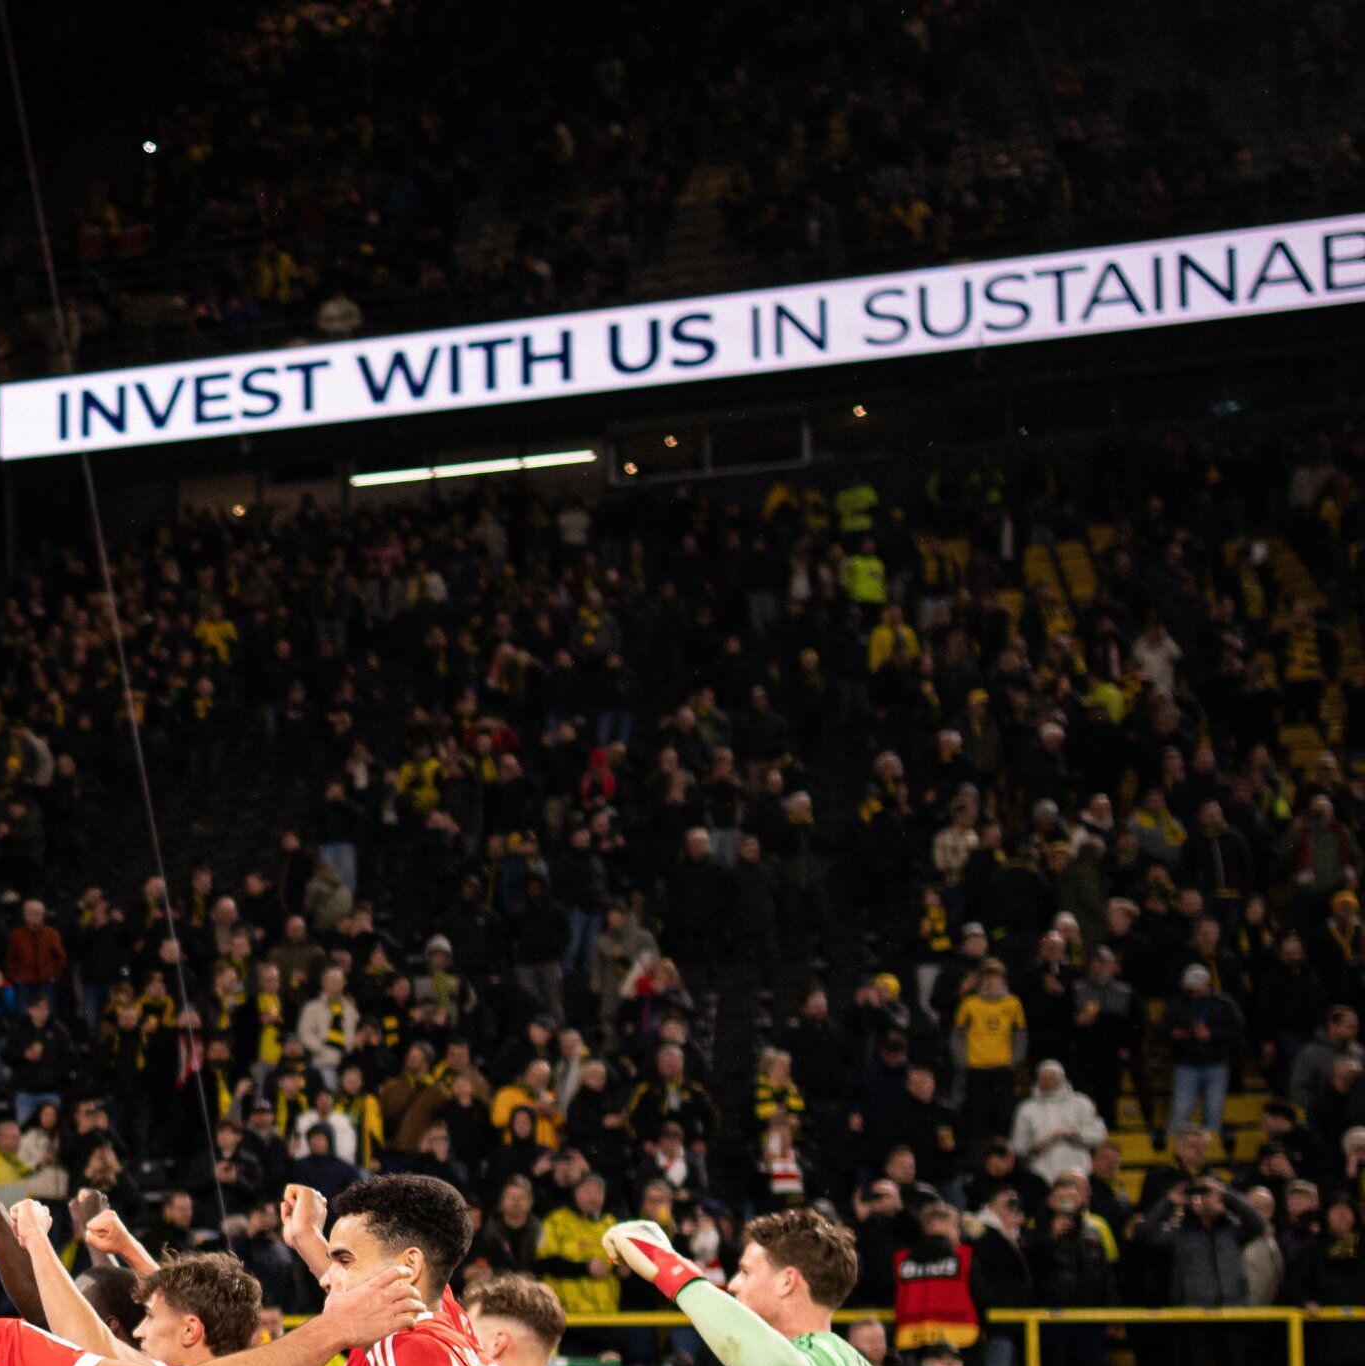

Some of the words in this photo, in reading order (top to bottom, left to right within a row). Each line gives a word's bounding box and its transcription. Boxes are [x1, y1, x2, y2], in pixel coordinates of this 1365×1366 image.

[58, 359, 330, 441] INVEST
[356, 328, 572, 403] WITH
[609, 313, 718, 375] US
[751, 296, 829, 360] IN
